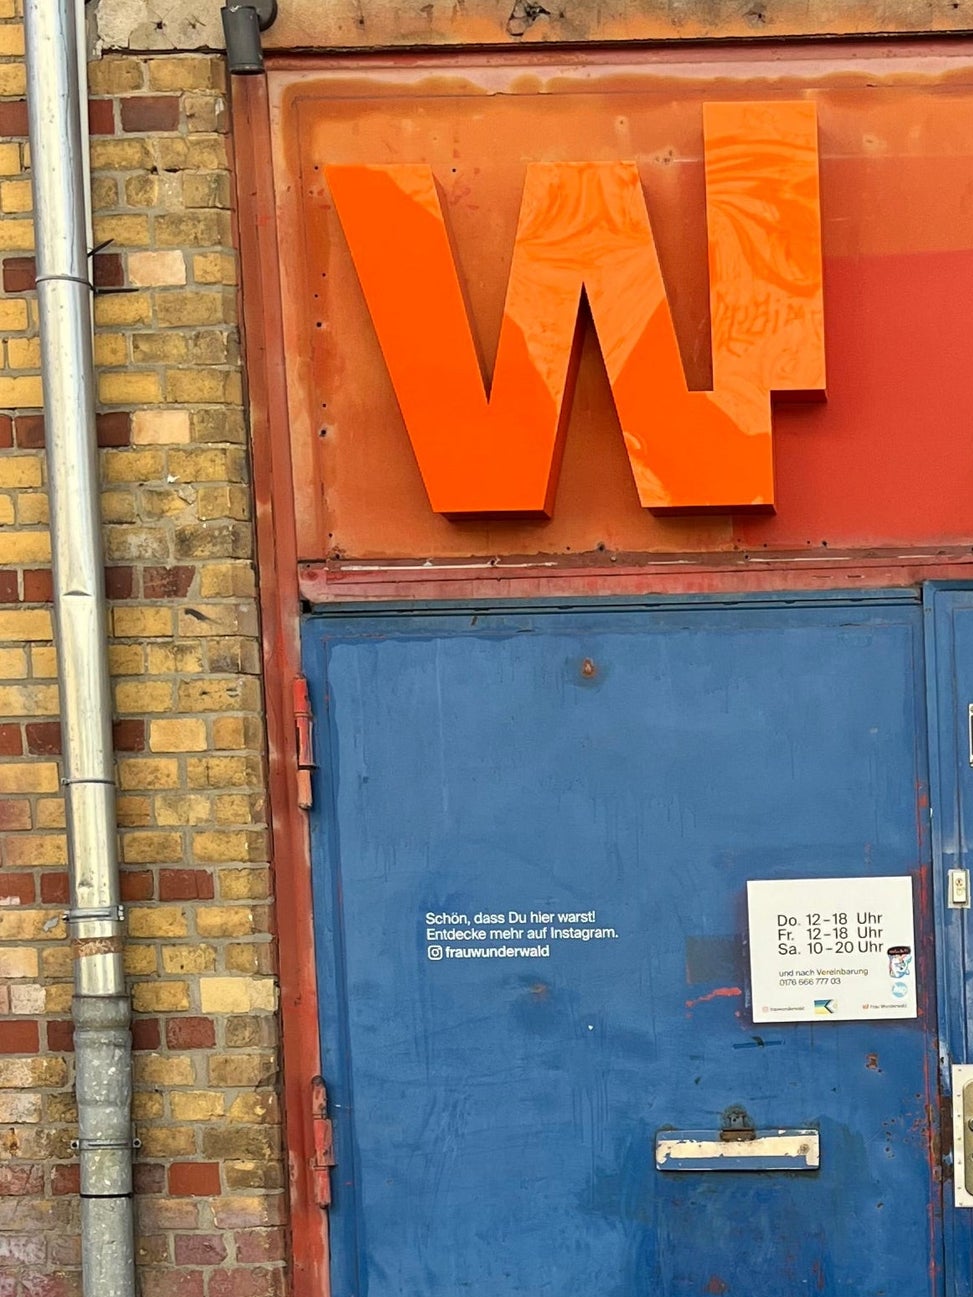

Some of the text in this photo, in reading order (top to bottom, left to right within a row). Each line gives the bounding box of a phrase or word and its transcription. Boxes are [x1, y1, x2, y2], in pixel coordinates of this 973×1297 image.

[325, 98, 828, 520] W
[425, 910, 596, 926] Schön, dass Du hier warst!
[777, 914, 801, 927] Do.
[857, 912, 883, 925] Uhr
[426, 927, 619, 941] Entdecke mehr auf Instagram.
[778, 928, 795, 941] Fr.
[857, 926, 883, 939] Uhr
[445, 945, 550, 958] frauwunderwald
[778, 942, 801, 955] Sa.
[858, 940, 884, 953] Uhr
[779, 968, 869, 977] und nach Vereinbarung
